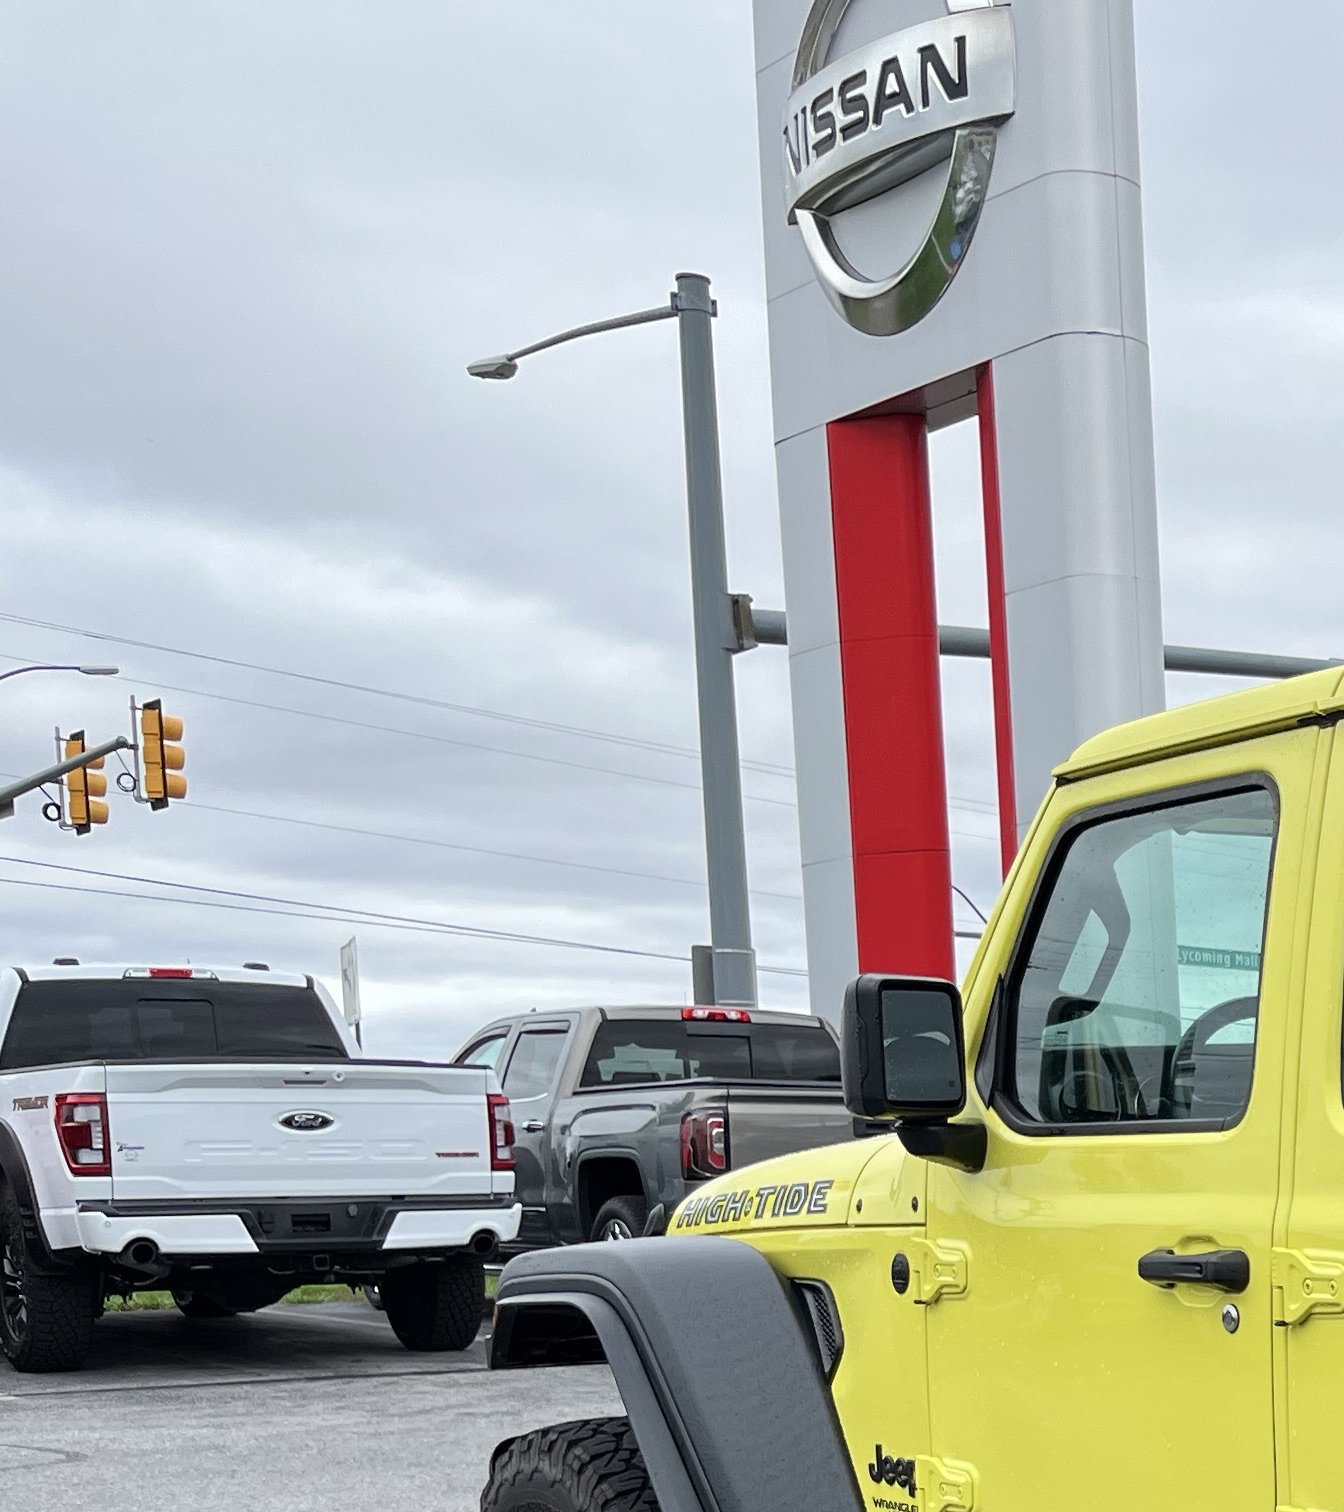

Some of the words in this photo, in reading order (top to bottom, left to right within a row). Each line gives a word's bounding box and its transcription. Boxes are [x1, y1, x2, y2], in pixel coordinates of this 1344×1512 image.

[783, 35, 968, 176] NISSAN
[1177, 949, 1231, 967] Lycoming
[1235, 953, 1259, 966] Mall
[291, 1114, 323, 1127] Ford
[677, 1190, 749, 1229] HIGH
[755, 1180, 834, 1220] TIDE
[868, 1443, 916, 1499] Jeep
